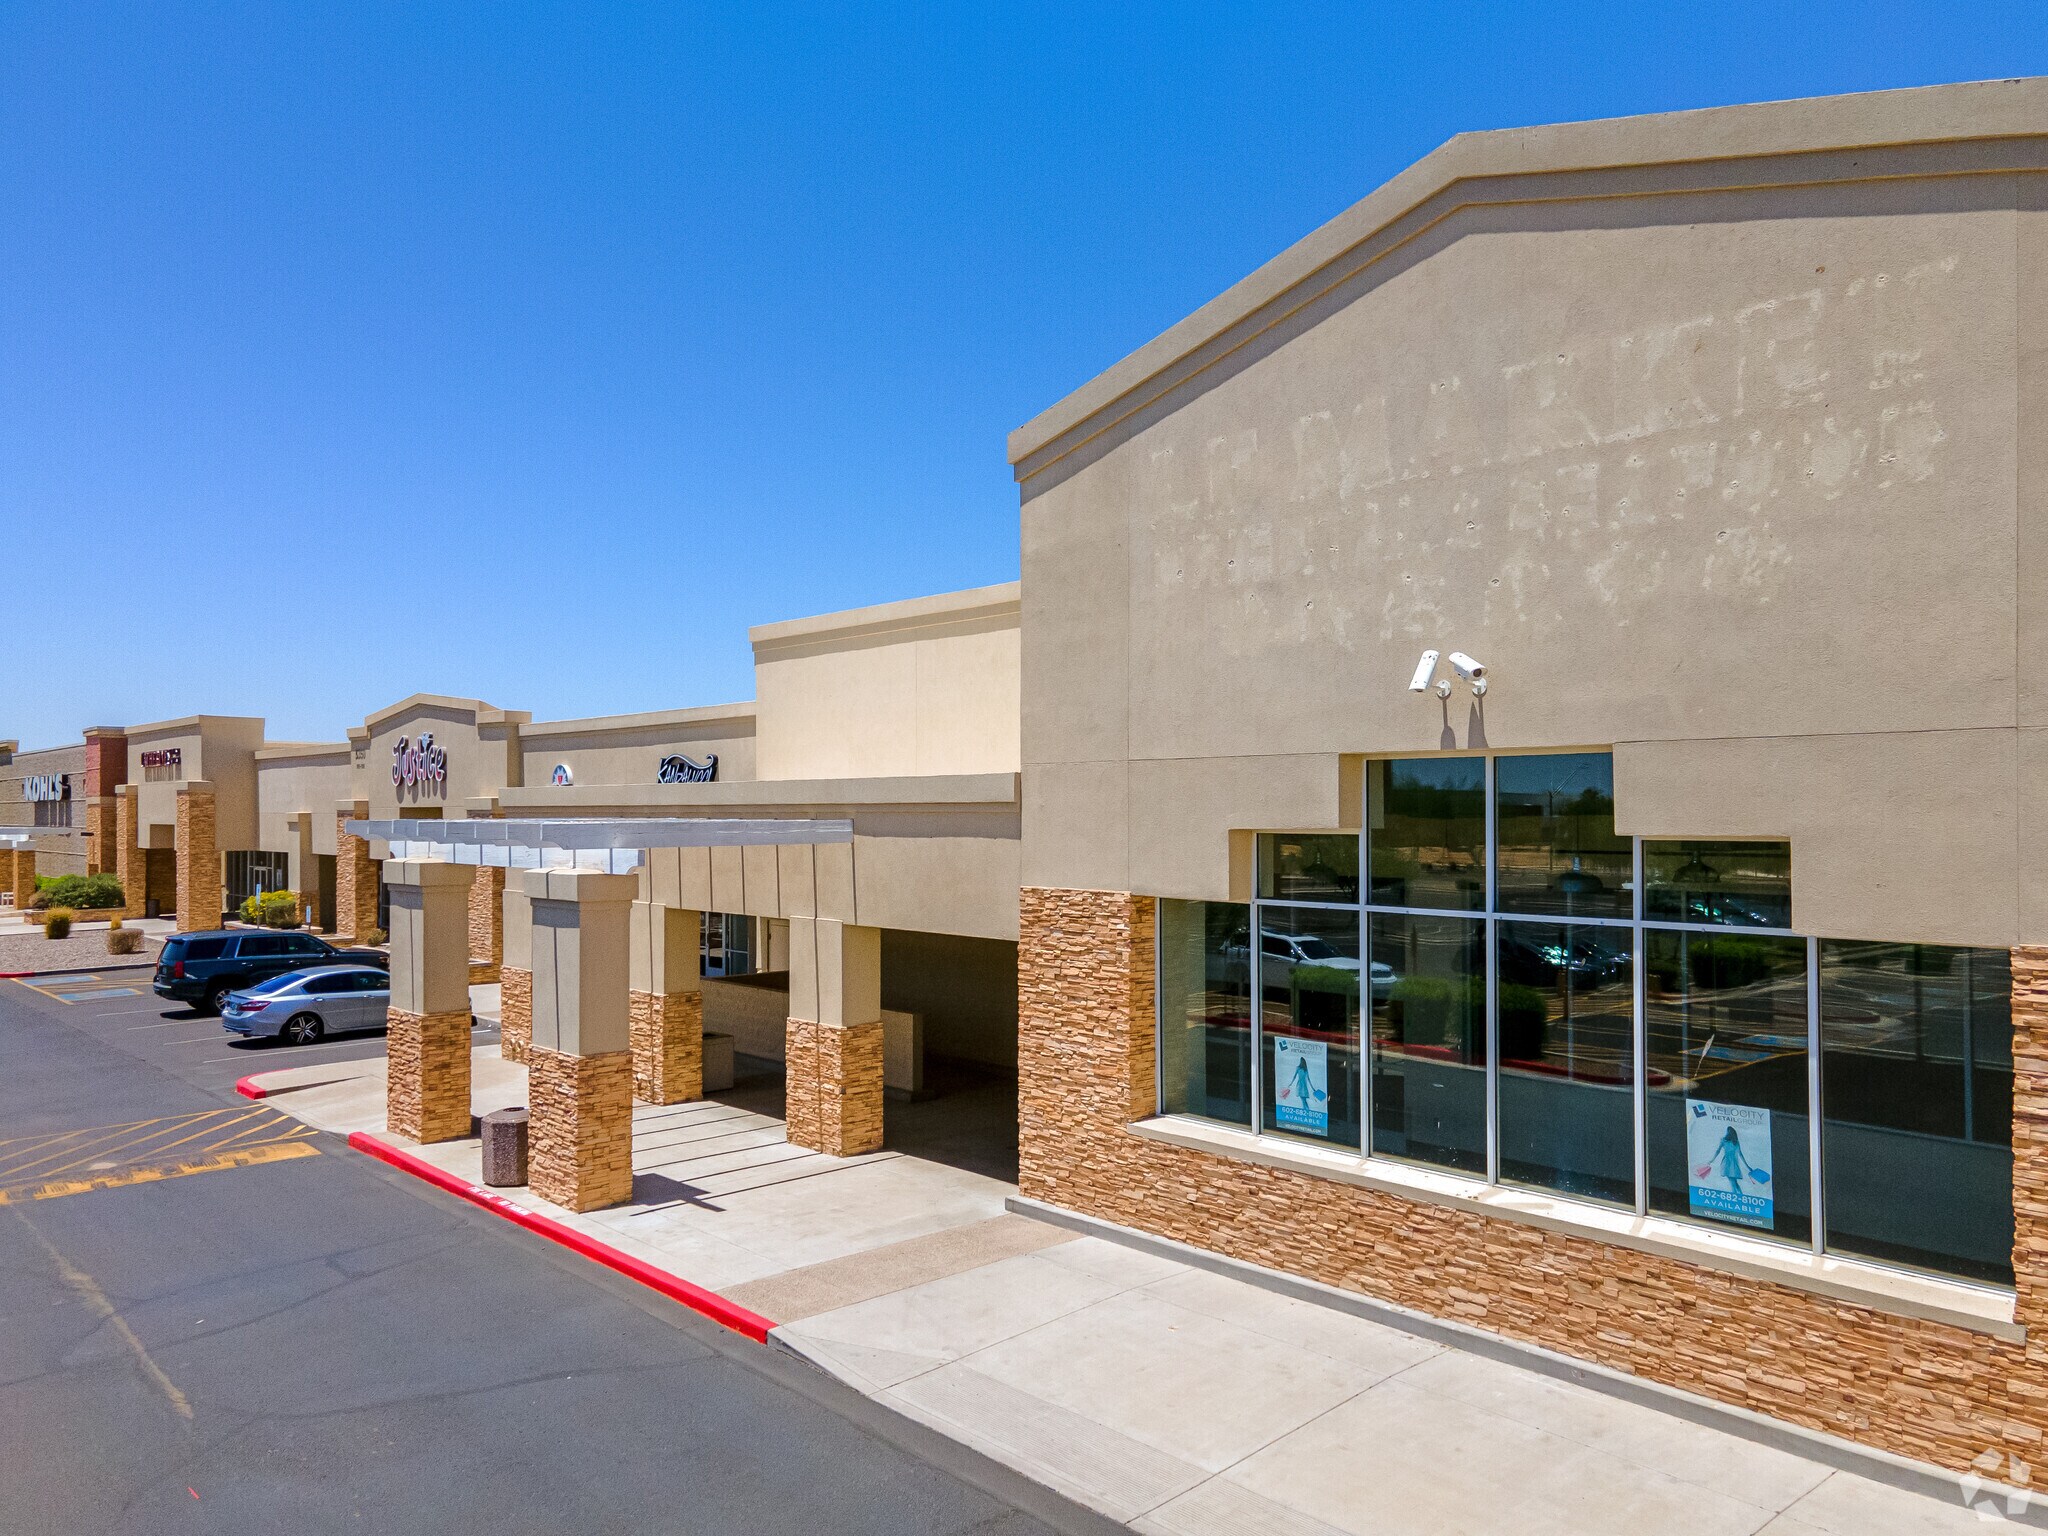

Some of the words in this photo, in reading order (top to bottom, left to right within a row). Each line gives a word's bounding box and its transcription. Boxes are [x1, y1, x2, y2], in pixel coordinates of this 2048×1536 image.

[392, 732, 445, 786] Justice
[24, 773, 62, 802] KOHL'S
[1289, 1041, 1324, 1052] VELOCITY
[1281, 1107, 1323, 1119] 602-682-8100
[1285, 1115, 1320, 1125] AVAILABLE
[1709, 1105, 1764, 1120] VELOCITY
[1698, 1188, 1766, 1207] 602-682-8100
[1704, 1199, 1761, 1214] AVAILABLE
[1704, 1211, 1763, 1225] VELOCITYRETAIL.COM
